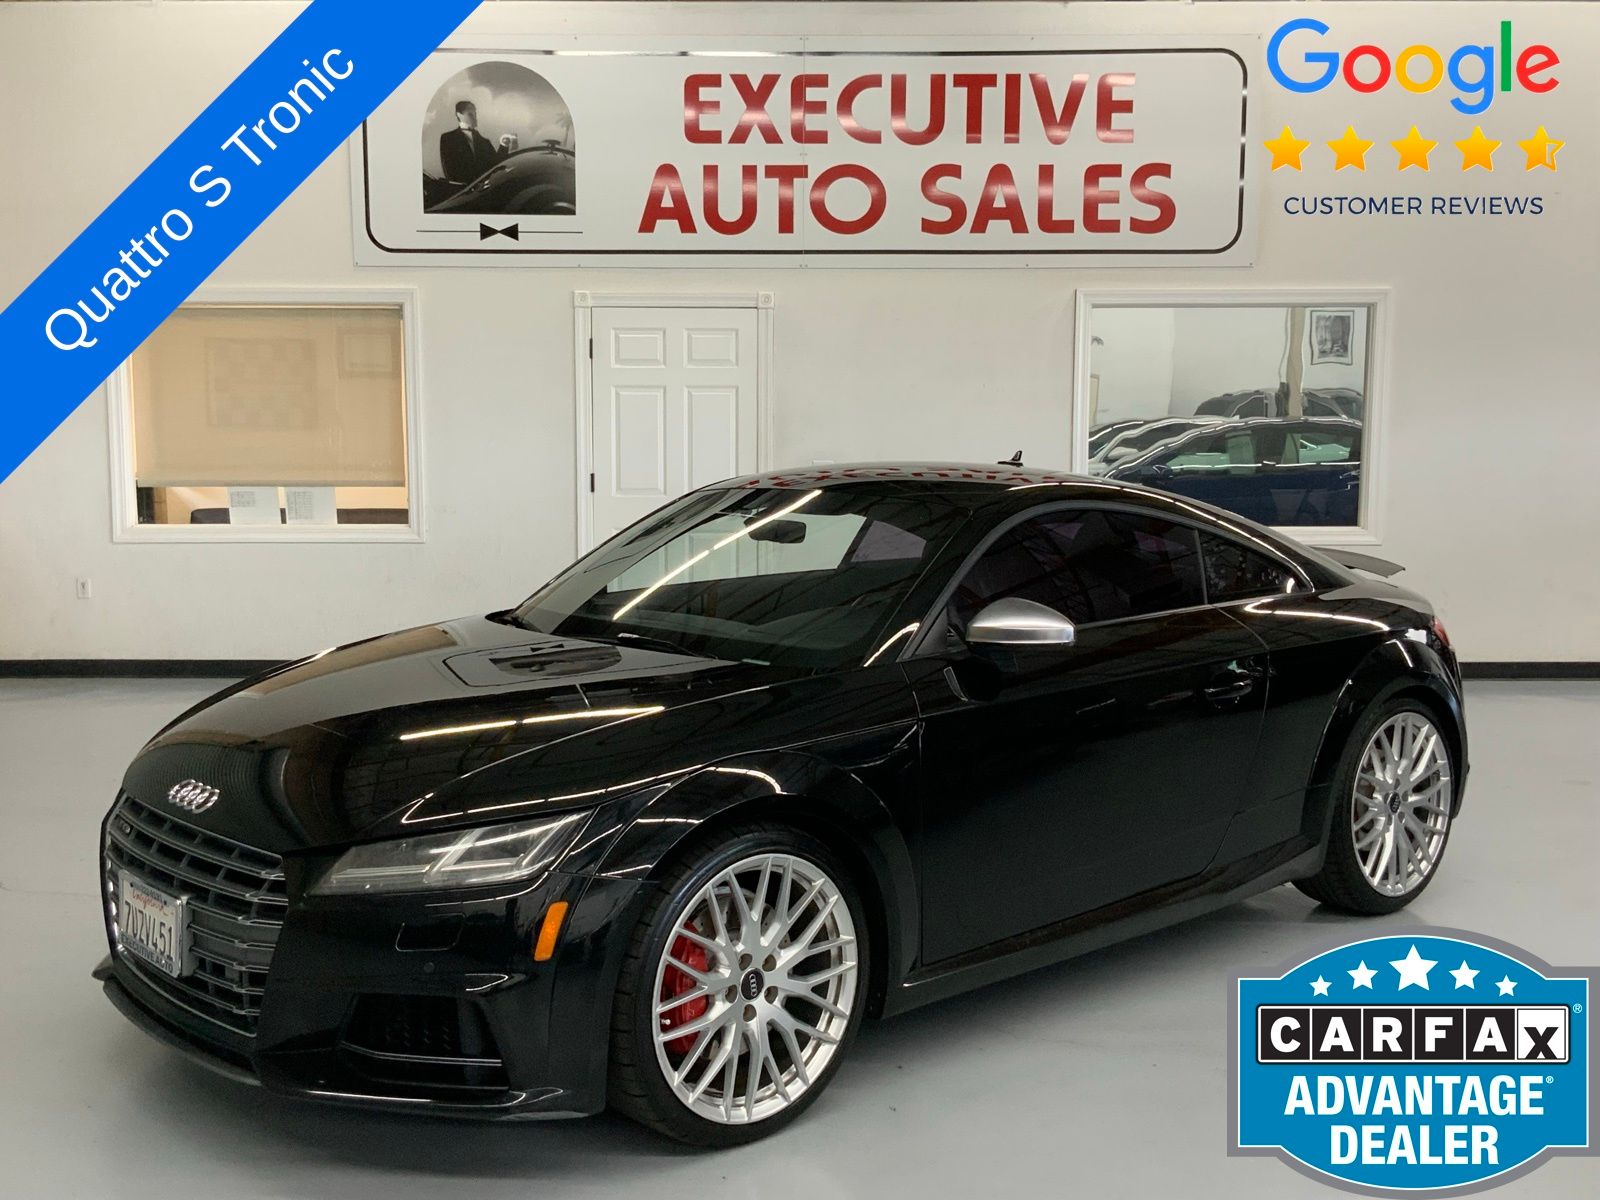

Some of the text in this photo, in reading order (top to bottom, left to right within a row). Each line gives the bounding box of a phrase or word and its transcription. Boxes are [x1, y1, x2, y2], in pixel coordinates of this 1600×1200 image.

[683, 72, 1137, 146] EXECUTIVE
[637, 162, 1177, 236] AUTO SALES
[124, 900, 174, 962] 7UZV451
